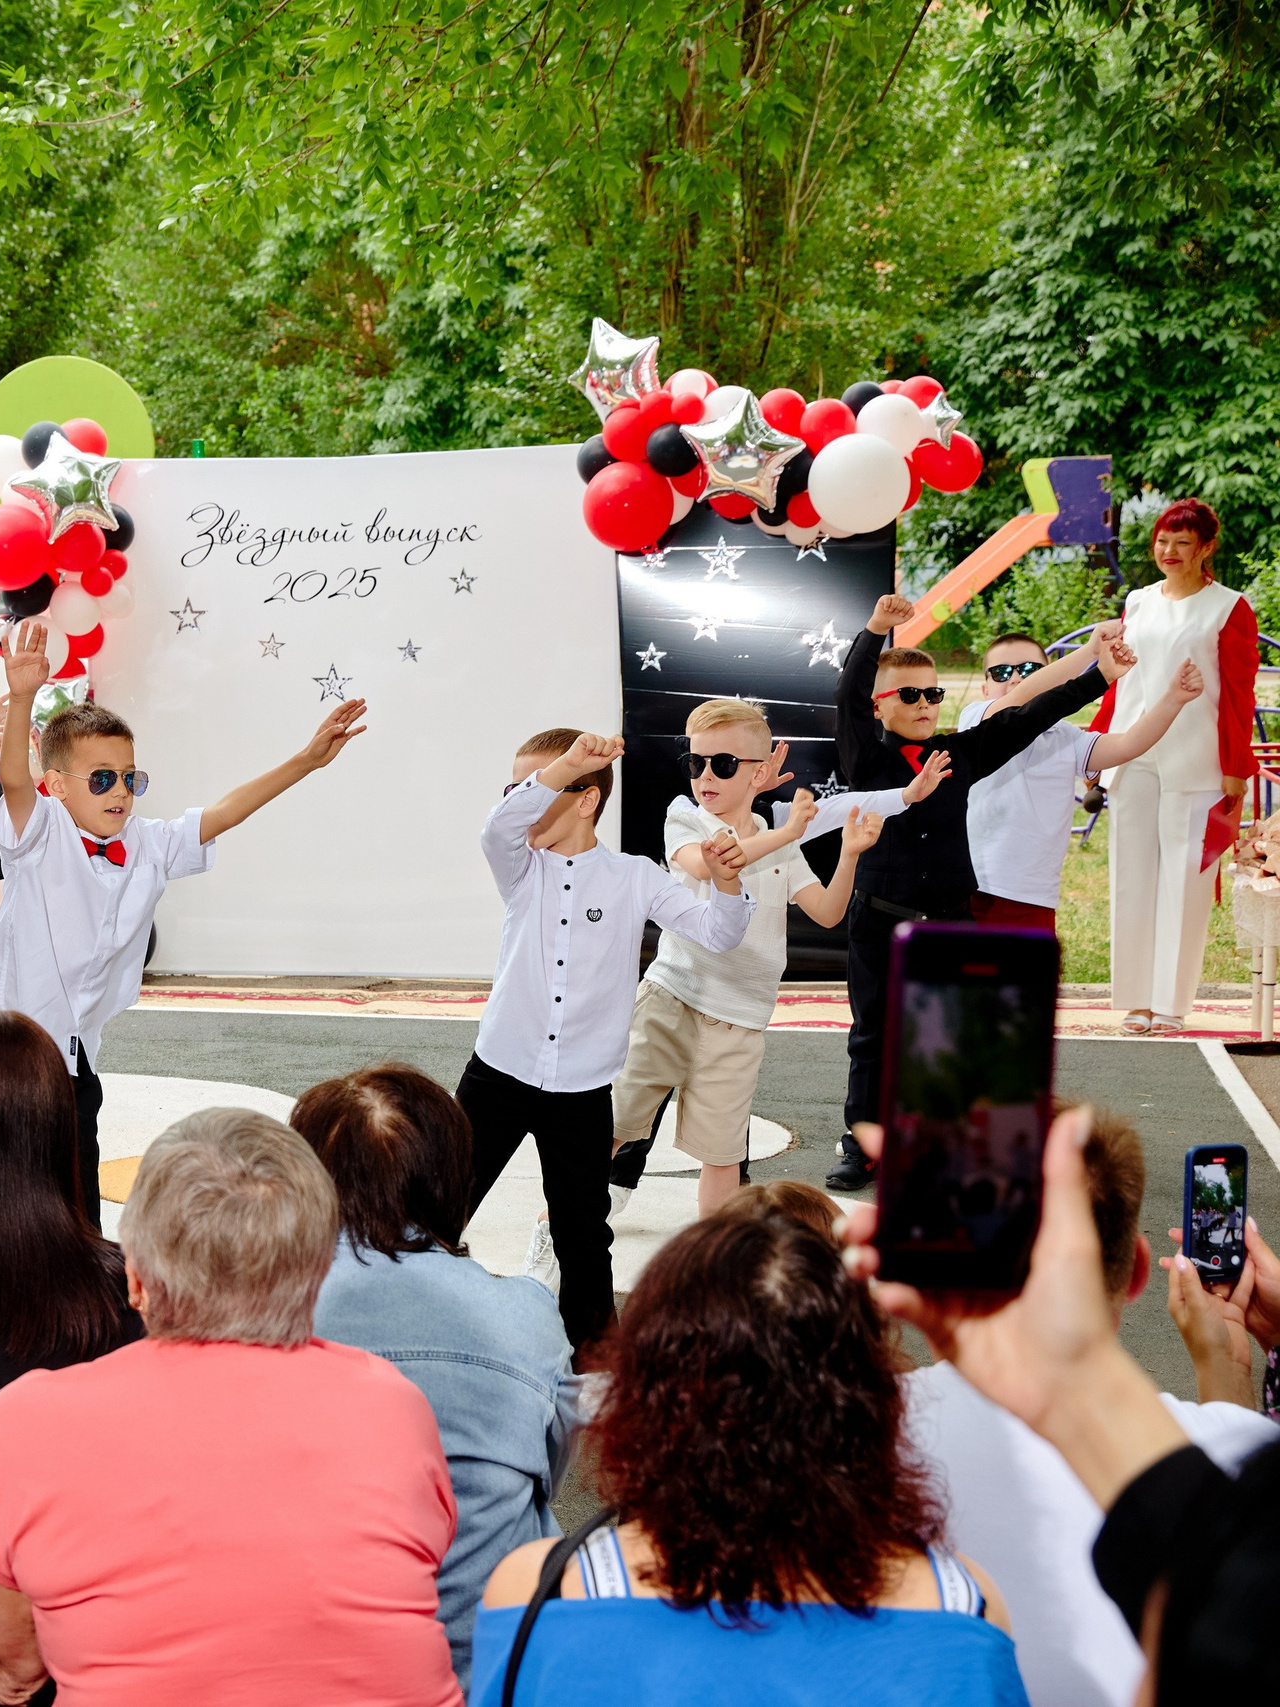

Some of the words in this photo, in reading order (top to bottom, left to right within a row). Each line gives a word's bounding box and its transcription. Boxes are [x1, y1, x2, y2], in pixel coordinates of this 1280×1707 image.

[181, 502, 354, 567] Звёздный
[365, 507, 483, 565] выпуск
[263, 567, 382, 604] 2025
